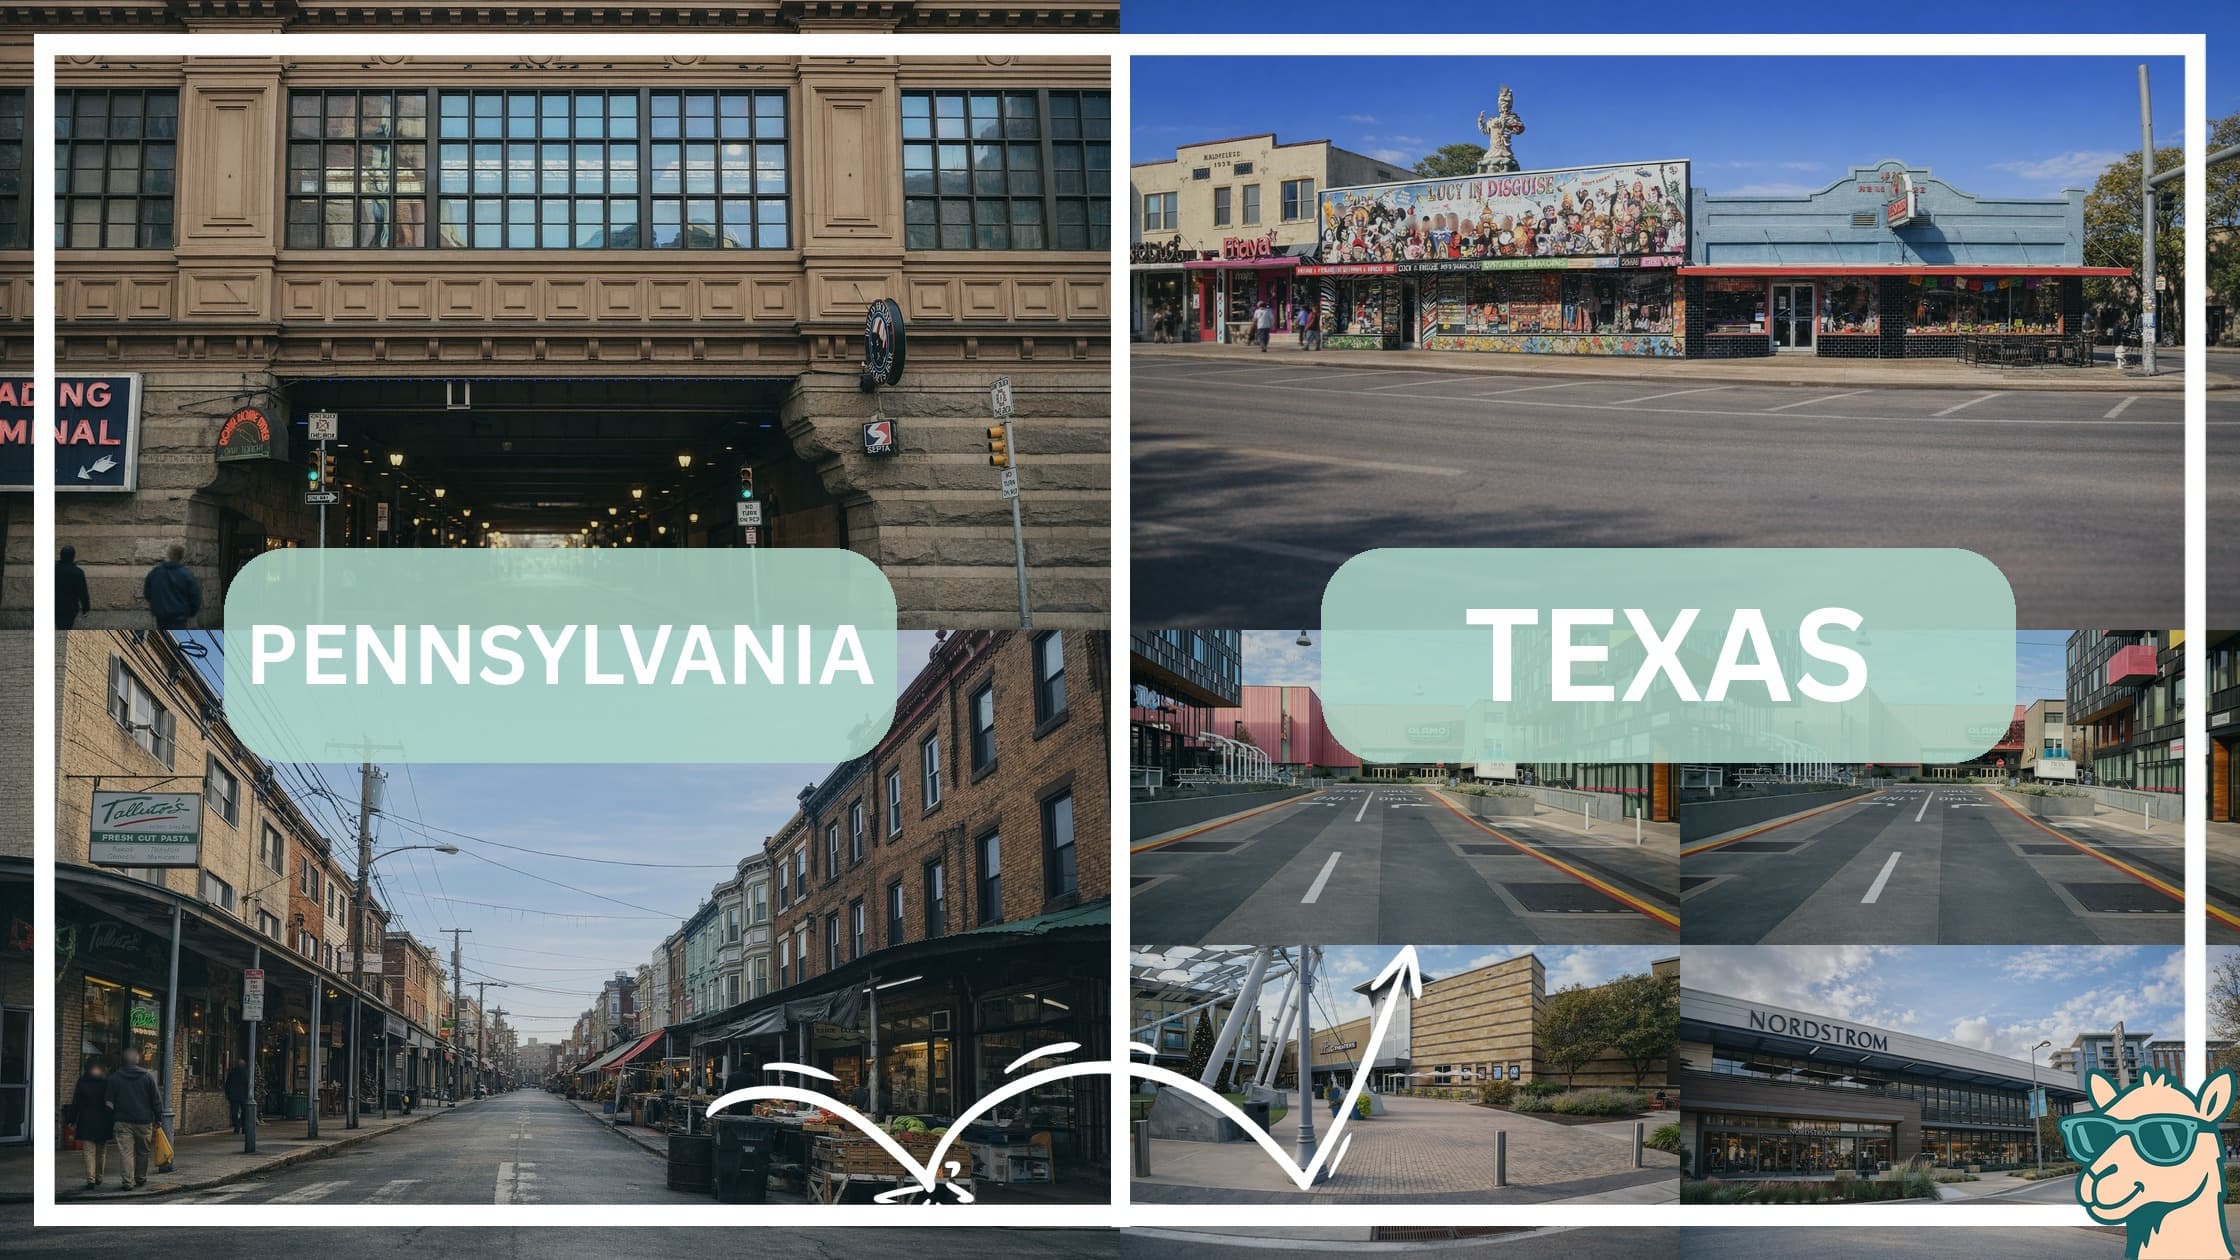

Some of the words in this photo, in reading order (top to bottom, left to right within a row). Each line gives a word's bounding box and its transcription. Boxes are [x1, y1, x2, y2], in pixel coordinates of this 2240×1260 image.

[1427, 183, 1463, 201] LUCY
[1469, 181, 1483, 199] IN
[1487, 176, 1555, 198] DISGUISE
[0, 382, 112, 408] ADNG
[867, 445, 891, 454] SEPTA
[101, 797, 190, 825] Talluto's
[102, 834, 134, 842] FRESH
[1750, 1009, 1888, 1051] NORDSTROM
[1790, 1129, 1832, 1137] NORDSTROM
